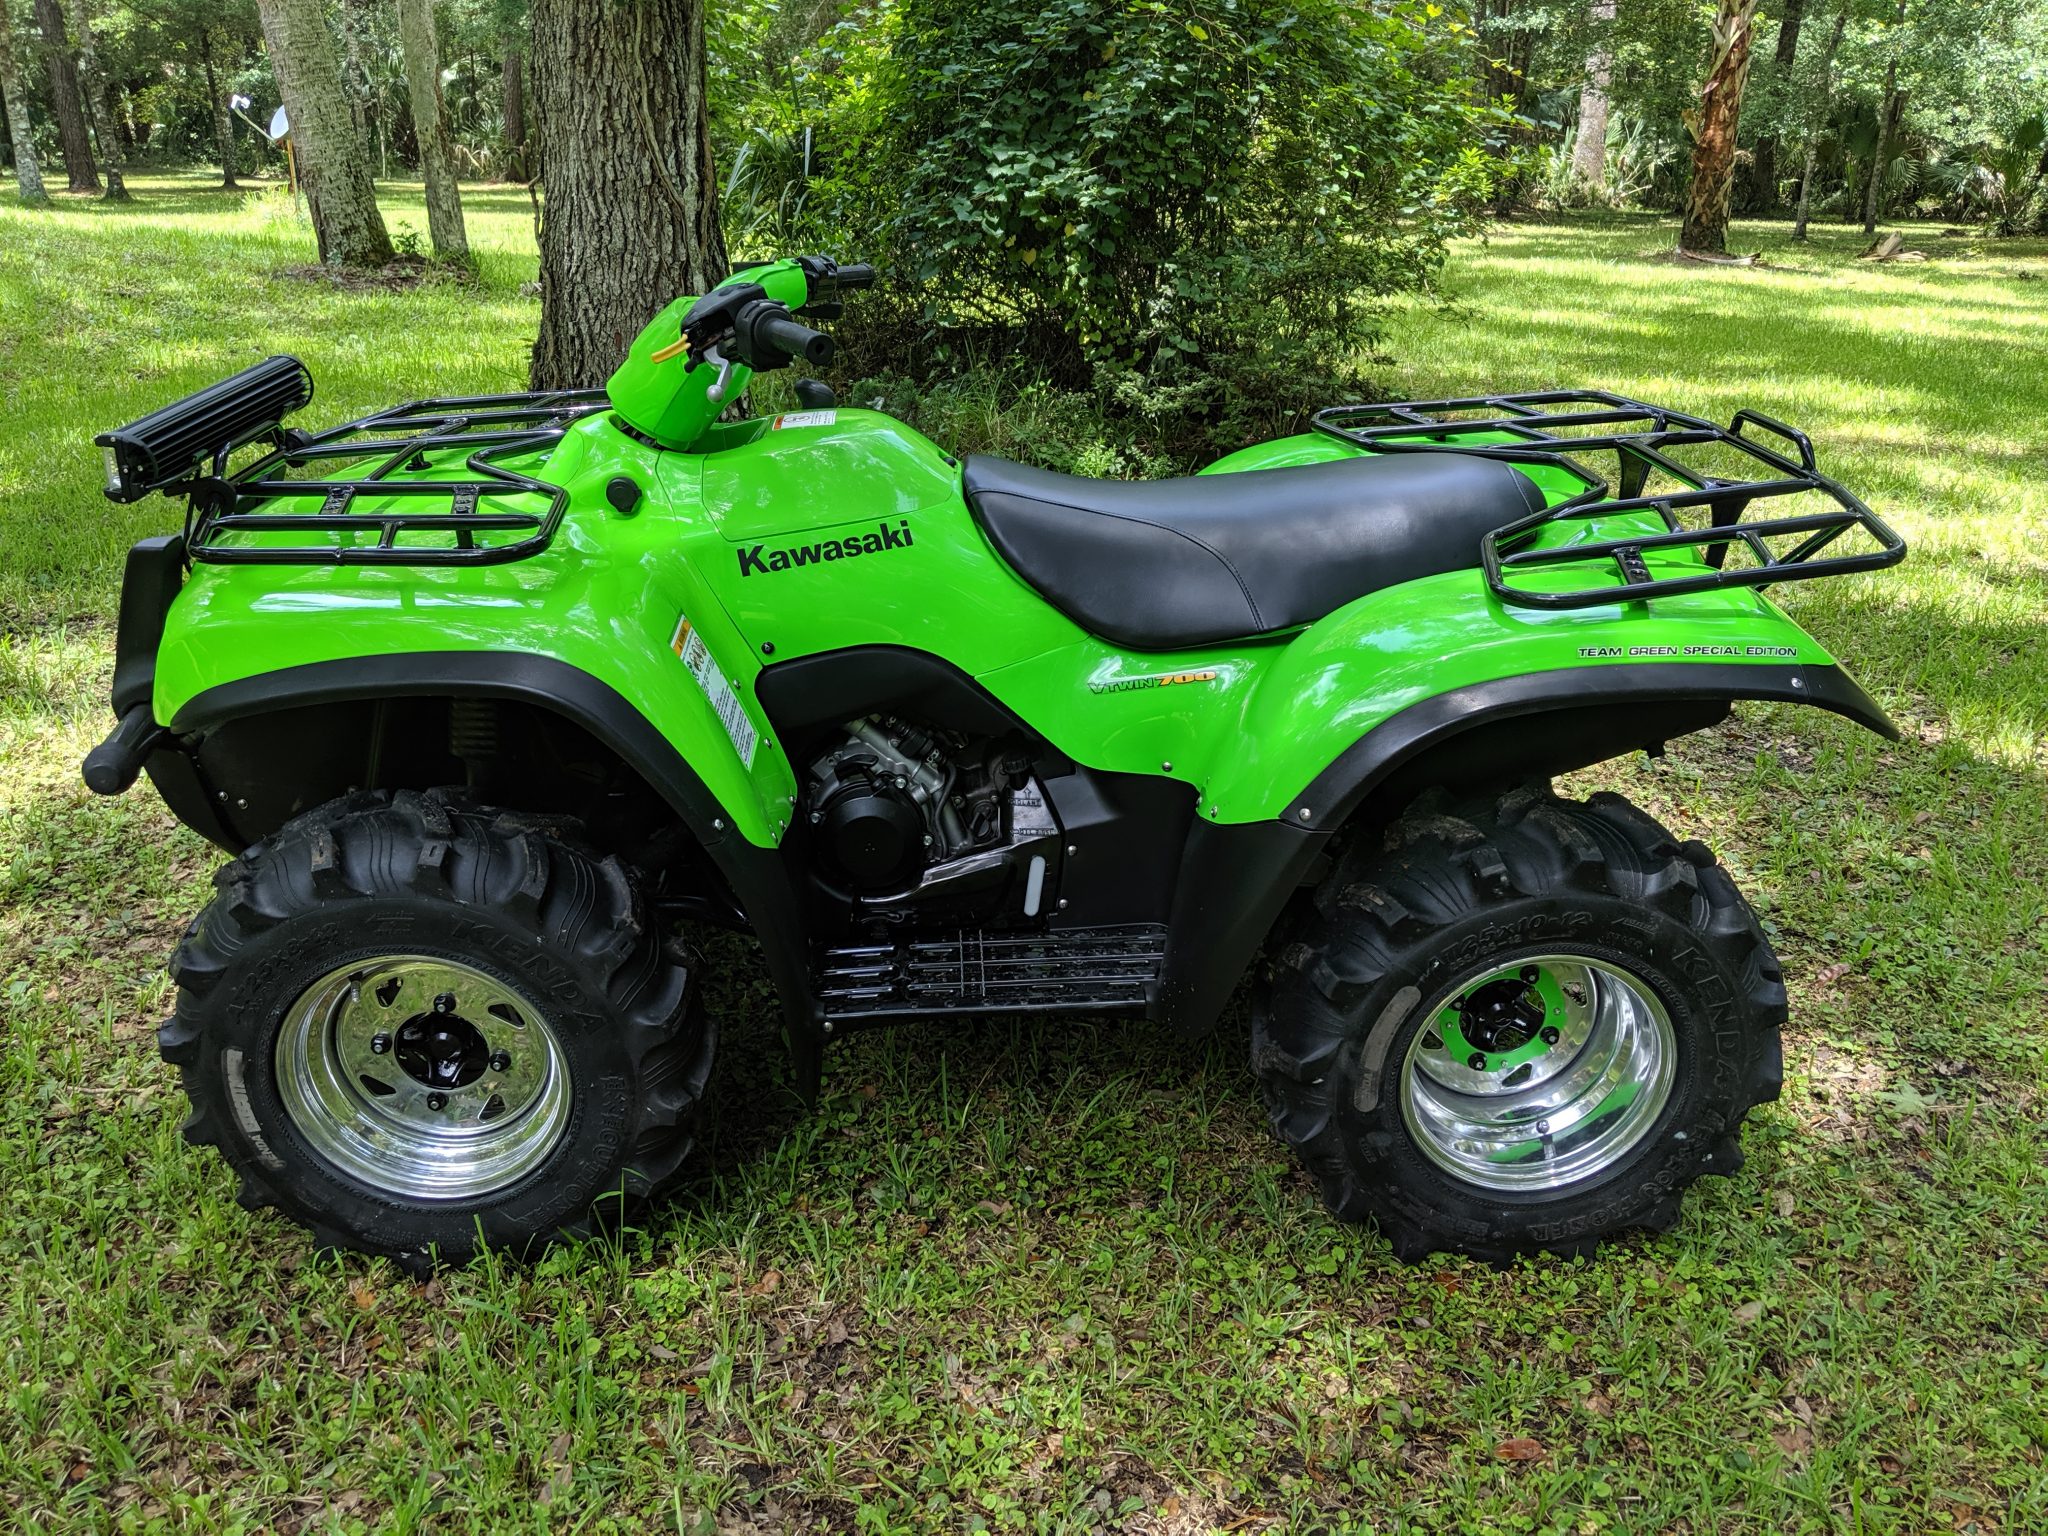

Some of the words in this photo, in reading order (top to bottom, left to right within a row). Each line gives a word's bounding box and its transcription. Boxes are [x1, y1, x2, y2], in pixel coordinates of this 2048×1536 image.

[736, 519, 914, 577] Kawasaki
[1154, 671, 1217, 687] 700
[1578, 646, 1622, 658] TEAM
[1628, 646, 1678, 656] GREEN
[1683, 646, 1741, 656] SPECIAL
[1746, 646, 1798, 657] EDITION
[450, 916, 609, 1037] KENDA
[1671, 946, 1743, 1089] KENDA
